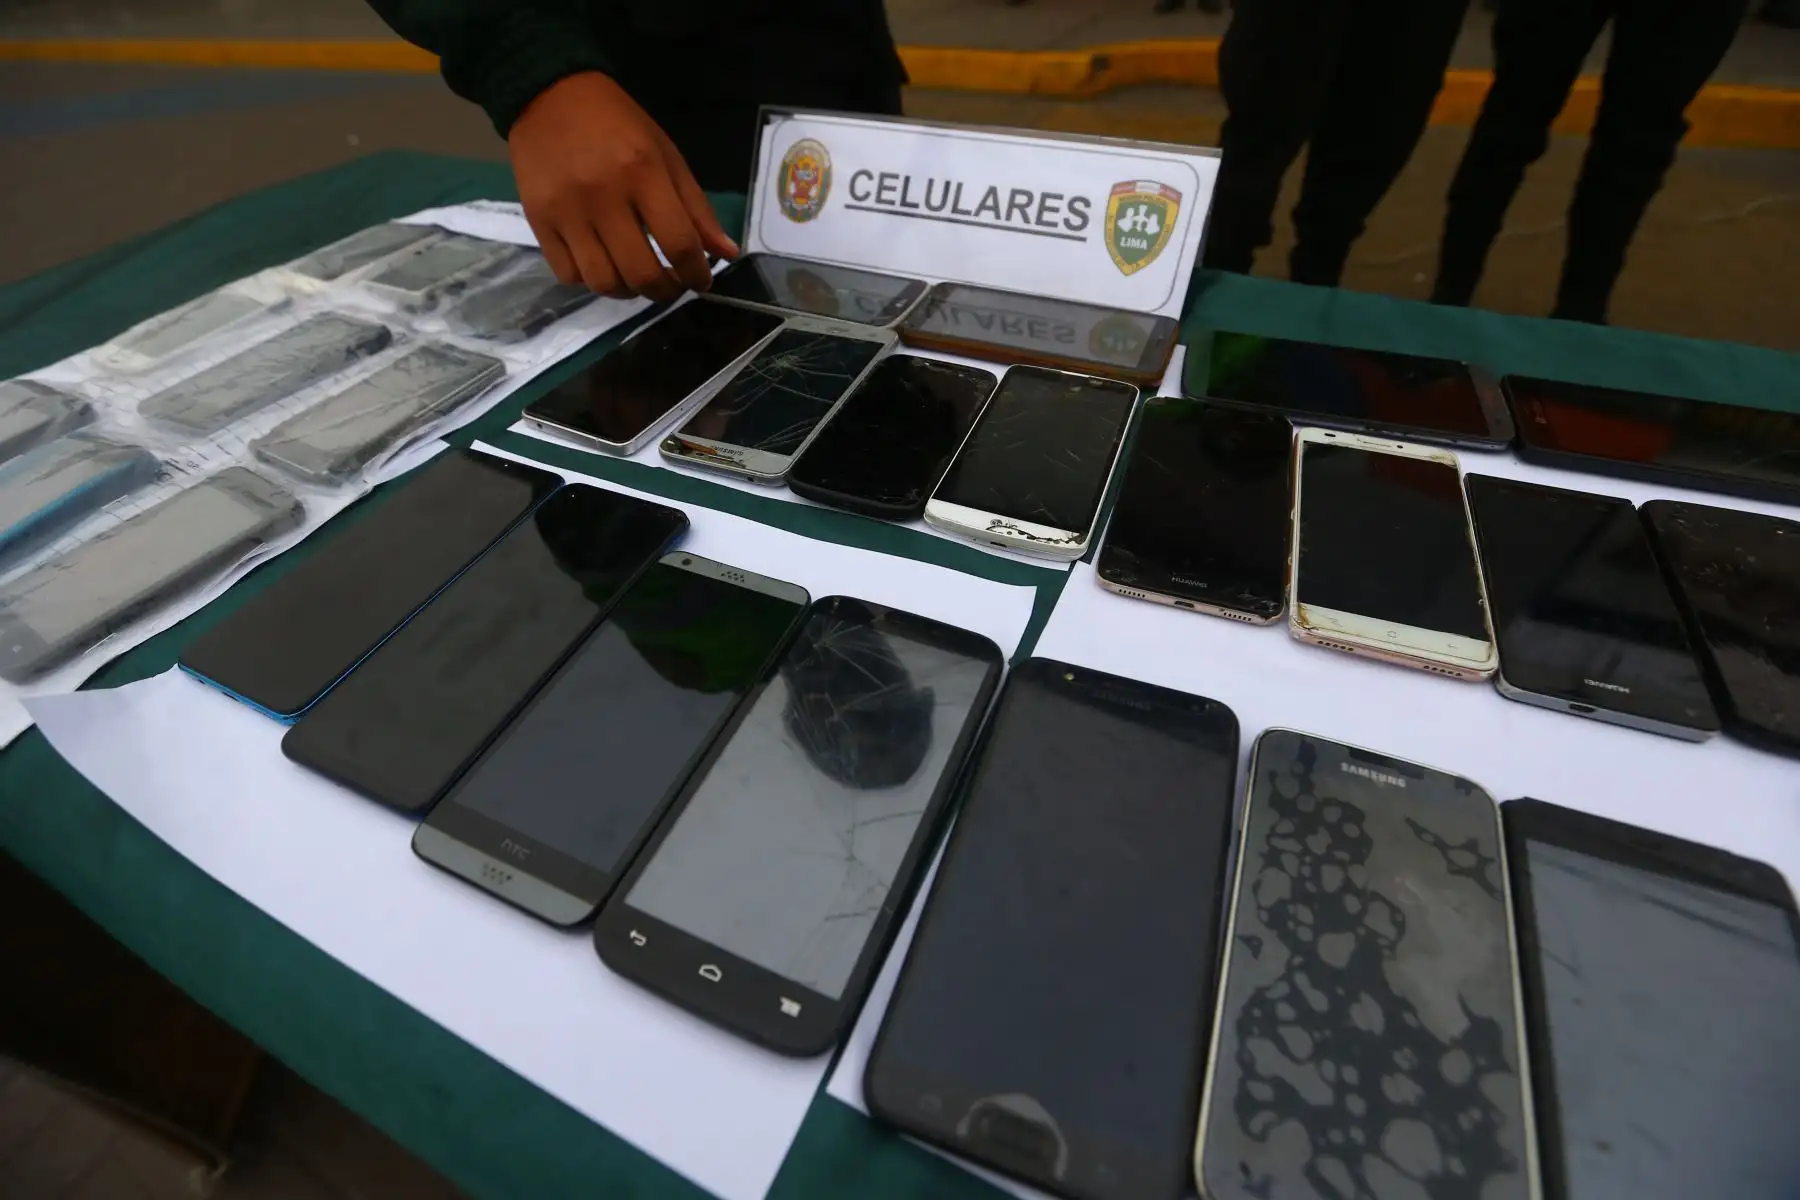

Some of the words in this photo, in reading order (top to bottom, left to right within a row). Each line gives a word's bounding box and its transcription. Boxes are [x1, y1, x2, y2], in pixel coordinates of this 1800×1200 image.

[849, 169, 1091, 232] CELULARES
[1120, 235, 1148, 250] LIMA
[1340, 762, 1406, 788] SAMSUNG
